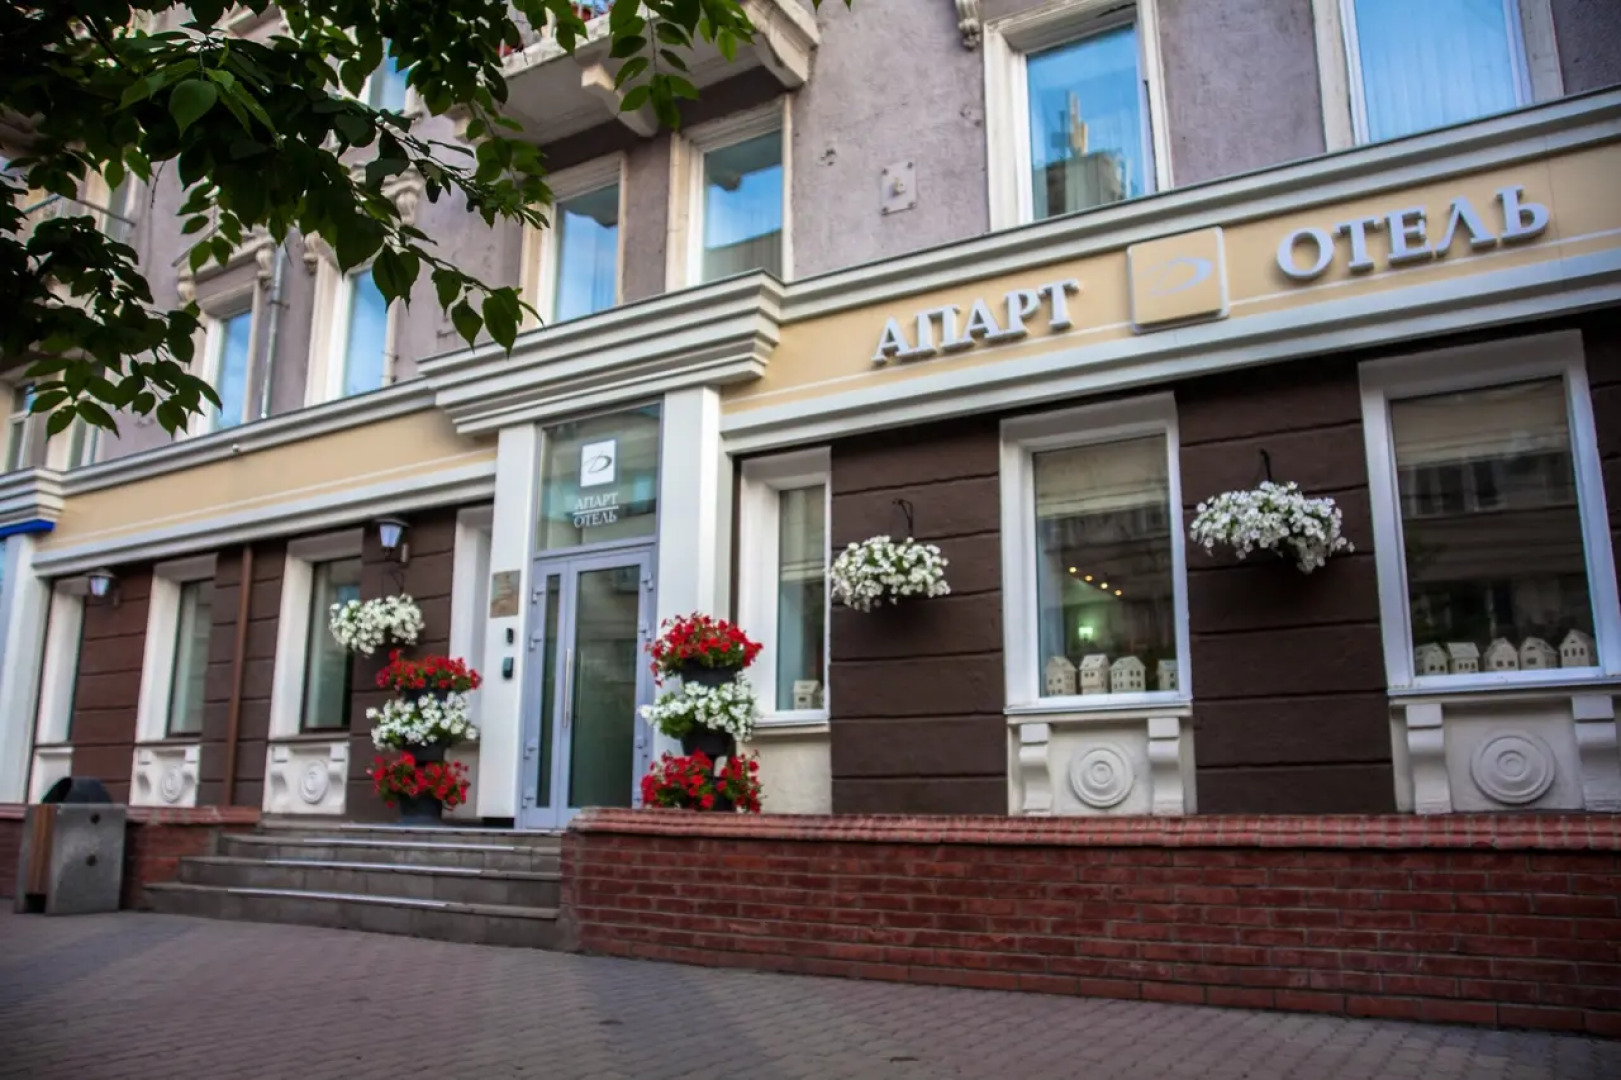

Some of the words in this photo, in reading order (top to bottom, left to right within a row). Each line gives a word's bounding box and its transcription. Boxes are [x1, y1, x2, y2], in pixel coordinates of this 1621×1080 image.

[871, 278, 1080, 365] АПАРТ
[1276, 185, 1551, 280] ОТЕЛЬ
[574, 492, 618, 510] АПАРТ
[573, 510, 618, 528] ОТЕЛЬ
